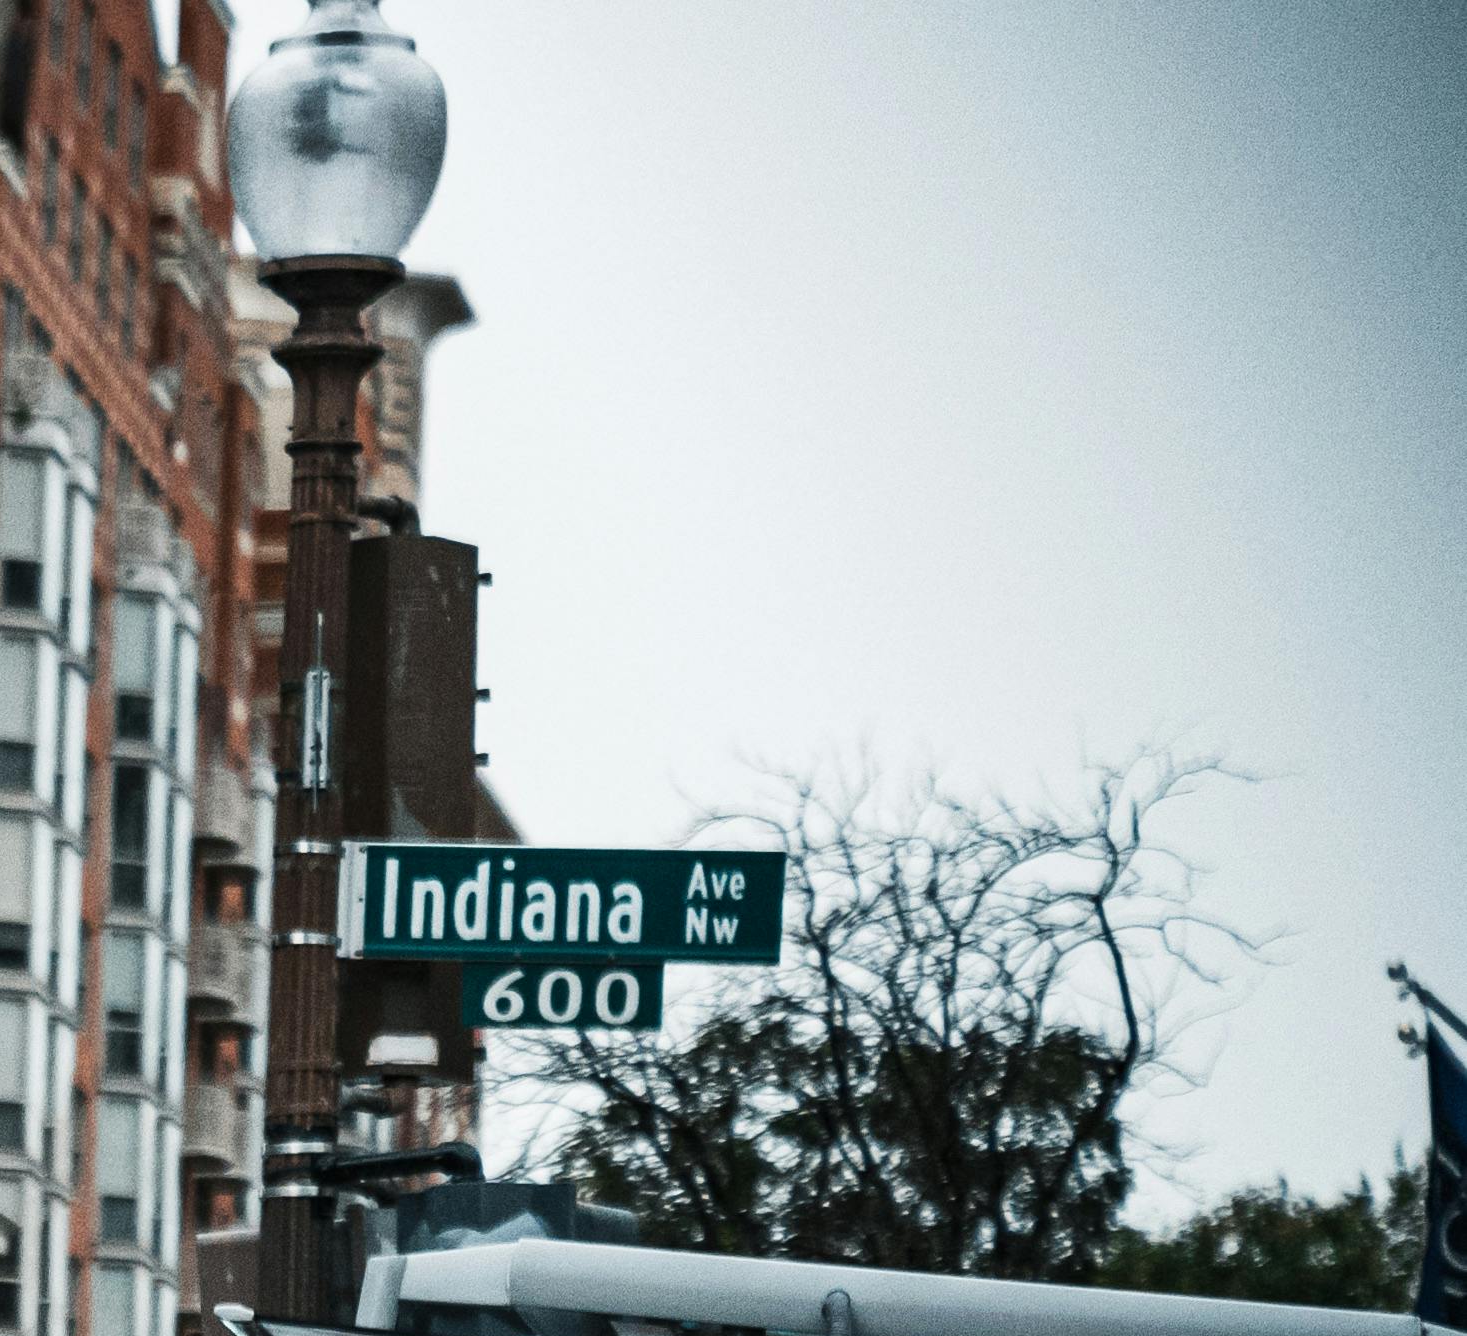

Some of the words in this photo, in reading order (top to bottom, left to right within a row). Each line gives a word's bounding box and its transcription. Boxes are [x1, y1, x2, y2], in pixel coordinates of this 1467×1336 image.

[383, 858, 644, 944] Indiana
[688, 863, 746, 901] Ave
[482, 970, 641, 1025] 600
